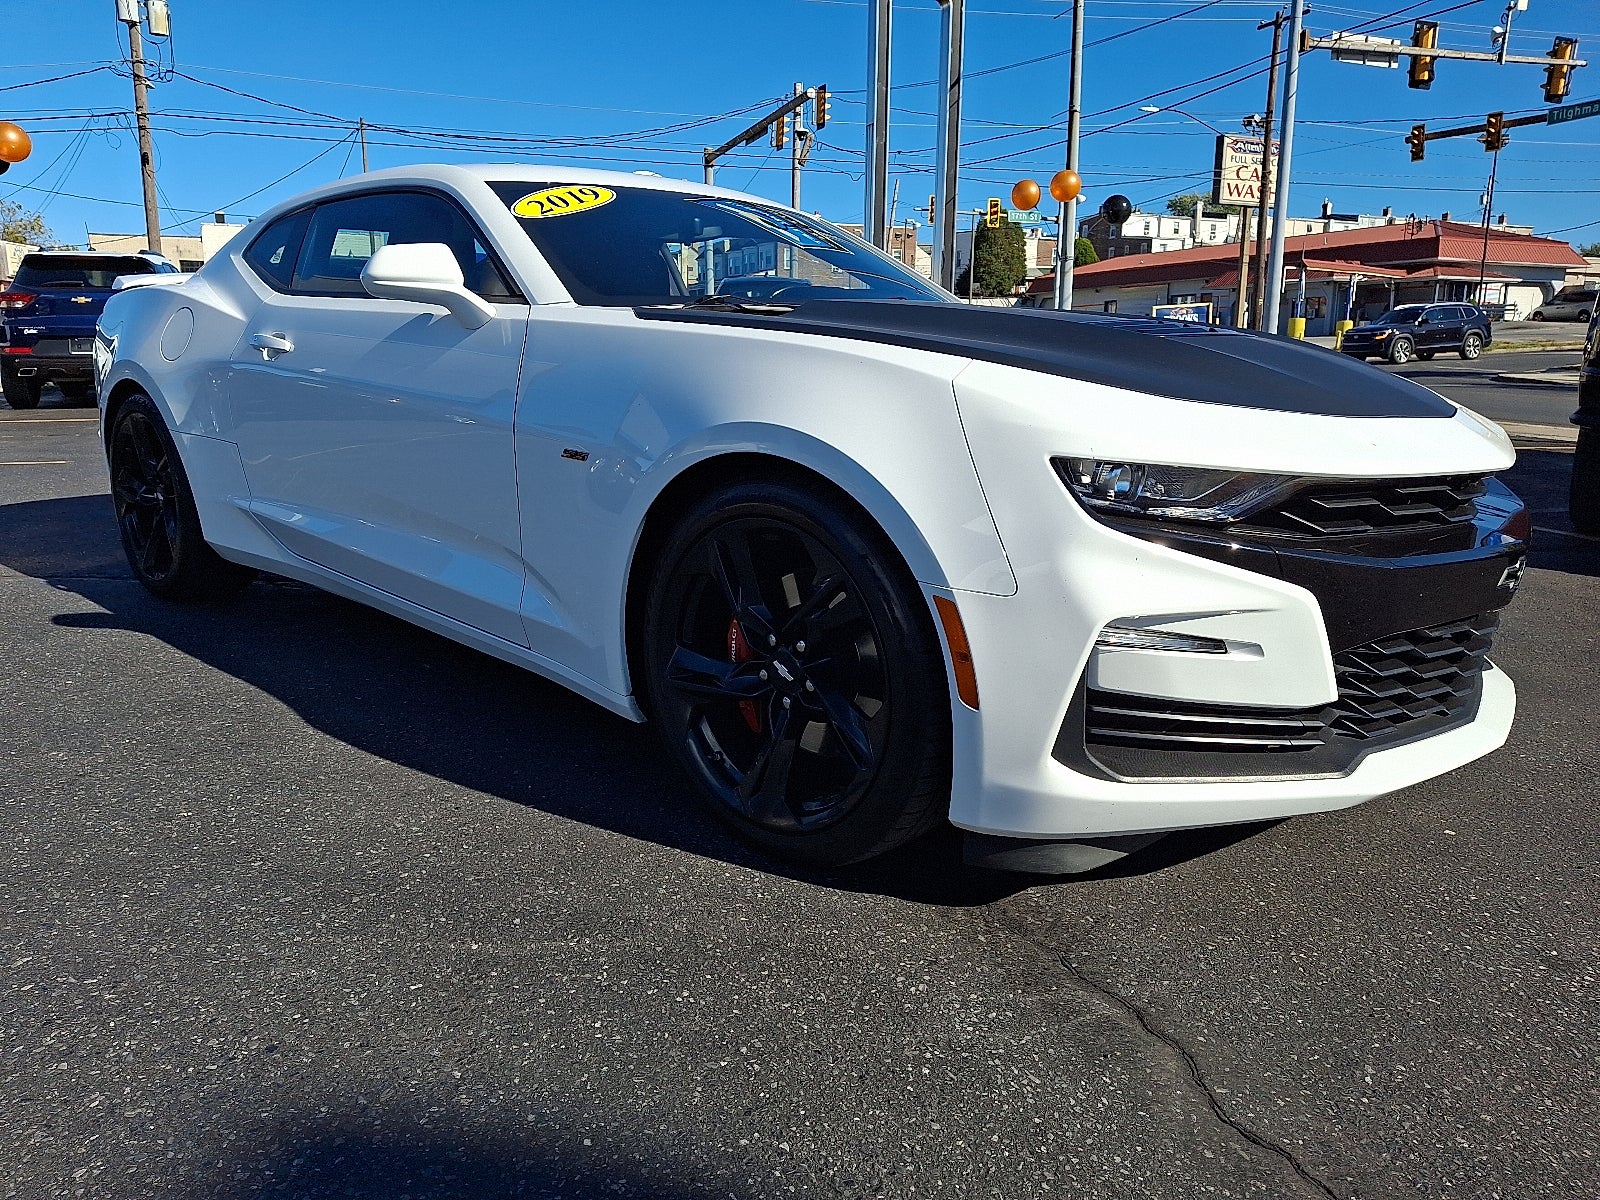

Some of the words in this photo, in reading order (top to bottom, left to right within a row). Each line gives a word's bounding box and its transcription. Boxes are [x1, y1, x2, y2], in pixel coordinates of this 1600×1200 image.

[1230, 154, 1248, 164] FULL
[1251, 156, 1277, 167] SERC
[1236, 165, 1271, 182] CA
[526, 187, 600, 215] 2019
[1029, 213, 1038, 221] St
